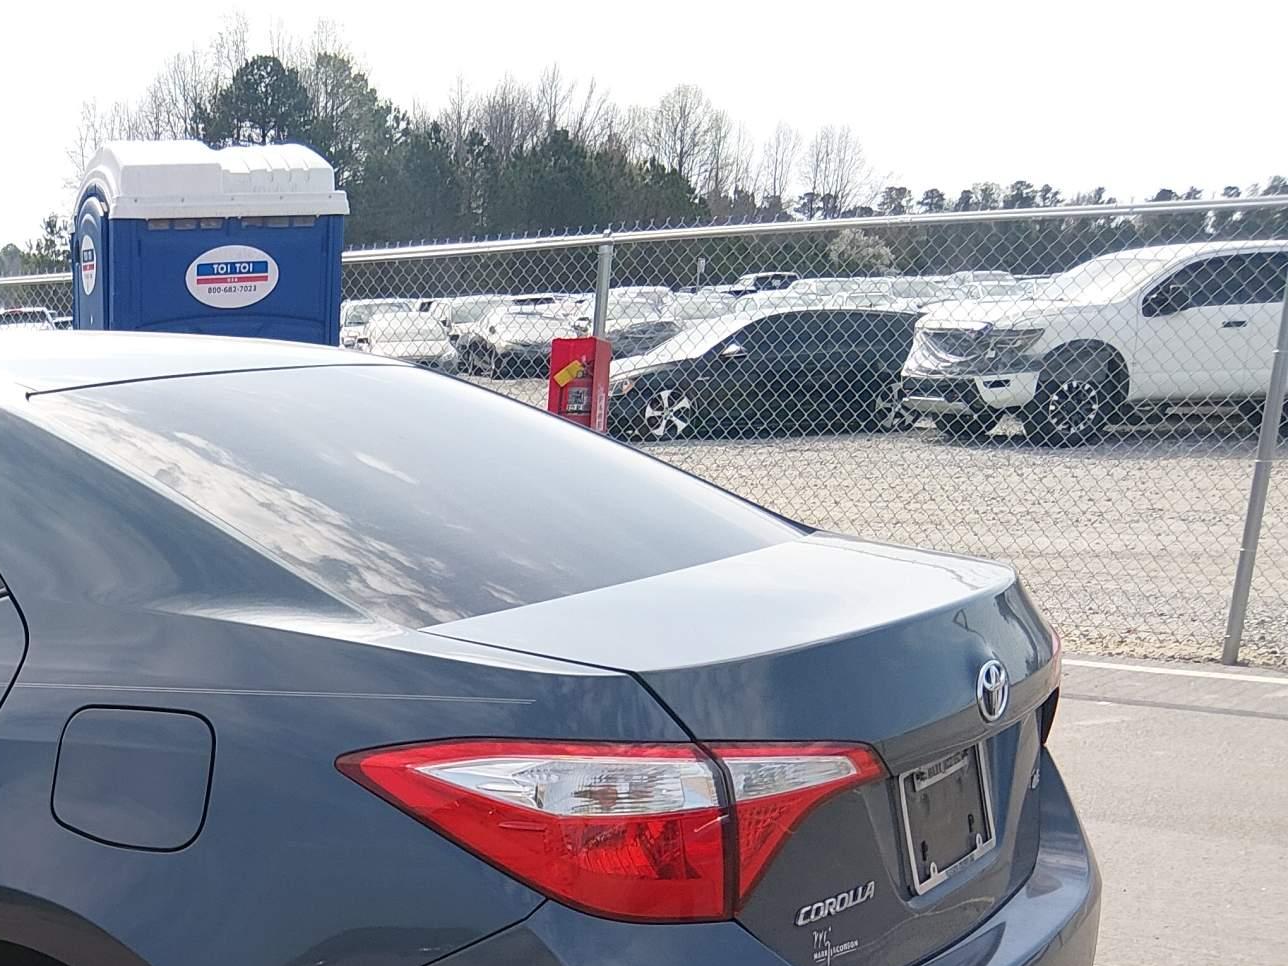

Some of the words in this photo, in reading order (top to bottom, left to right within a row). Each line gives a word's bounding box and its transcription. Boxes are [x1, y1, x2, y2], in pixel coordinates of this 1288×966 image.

[212, 264, 231, 274] TOI
[235, 262, 253, 273] TOI
[796, 880, 875, 926] COROLLA
